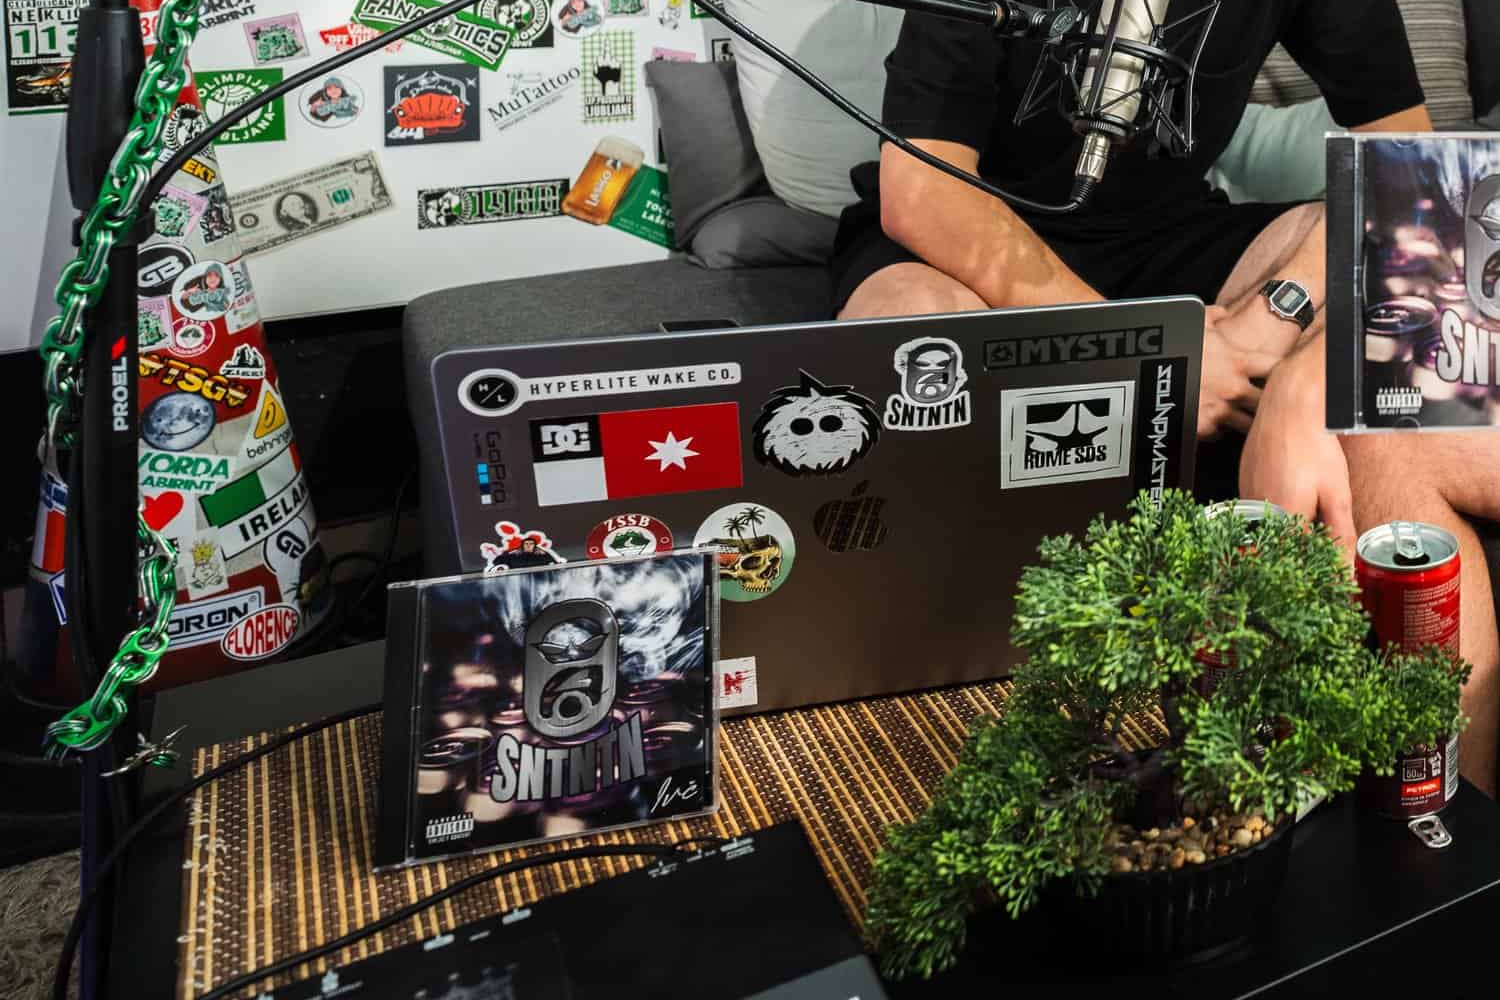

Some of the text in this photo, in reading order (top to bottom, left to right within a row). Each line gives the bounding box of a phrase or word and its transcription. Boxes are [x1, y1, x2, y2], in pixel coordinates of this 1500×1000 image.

[12, 9, 36, 23] NE
[487, 65, 581, 122] MuTattoo
[1020, 327, 1162, 363] MYSTIC
[112, 356, 129, 431] PROEL
[529, 368, 736, 397] HYPERLITE WAKE CO.
[887, 400, 967, 428] SNTNTN
[1023, 444, 1108, 471] ROME SDS
[140, 476, 216, 493] ABIRINT
[239, 482, 307, 542] IRELA
[603, 514, 651, 532] ZSSB
[226, 606, 298, 656] FLORENCE
[489, 710, 648, 803] SNTNTN
